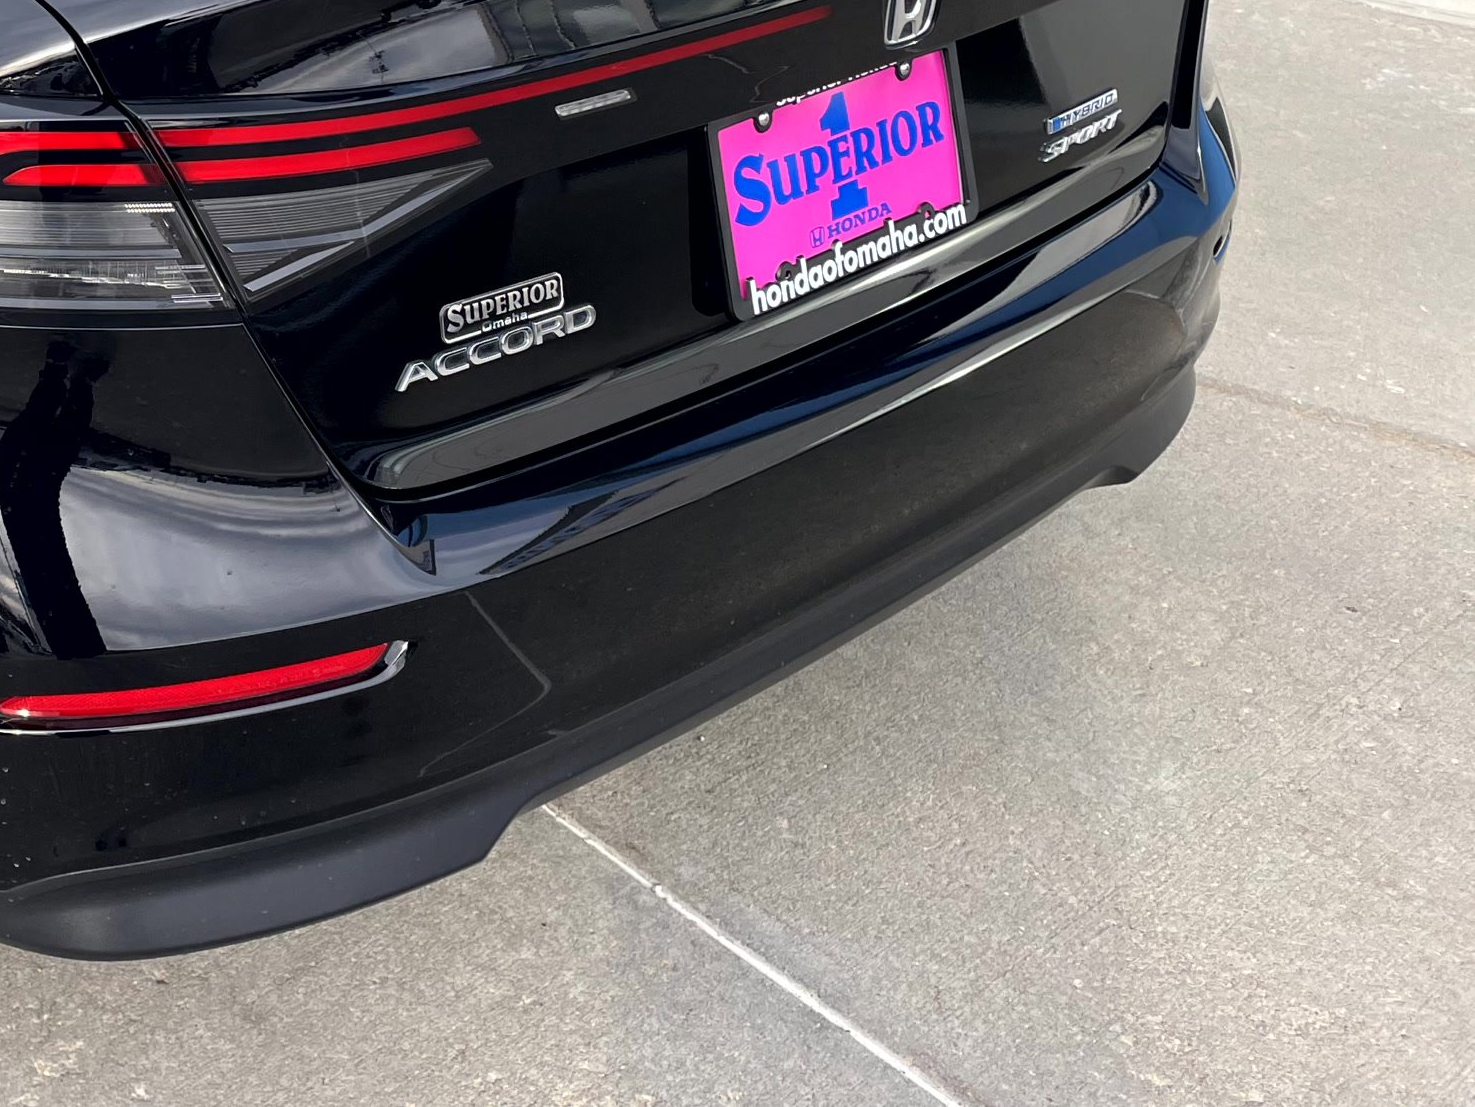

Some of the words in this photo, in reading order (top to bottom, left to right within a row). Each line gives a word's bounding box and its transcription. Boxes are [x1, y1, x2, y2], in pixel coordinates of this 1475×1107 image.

[1042, 108, 1123, 163] SPORT
[1059, 92, 1115, 124] HYBRID
[733, 100, 945, 227] SUPERIOR
[826, 202, 893, 240] HONDA
[749, 203, 968, 316] hondaofomaha.com
[446, 278, 560, 333] SUPERIOR
[480, 311, 529, 333] Omaha
[393, 304, 598, 393] ACCORD
